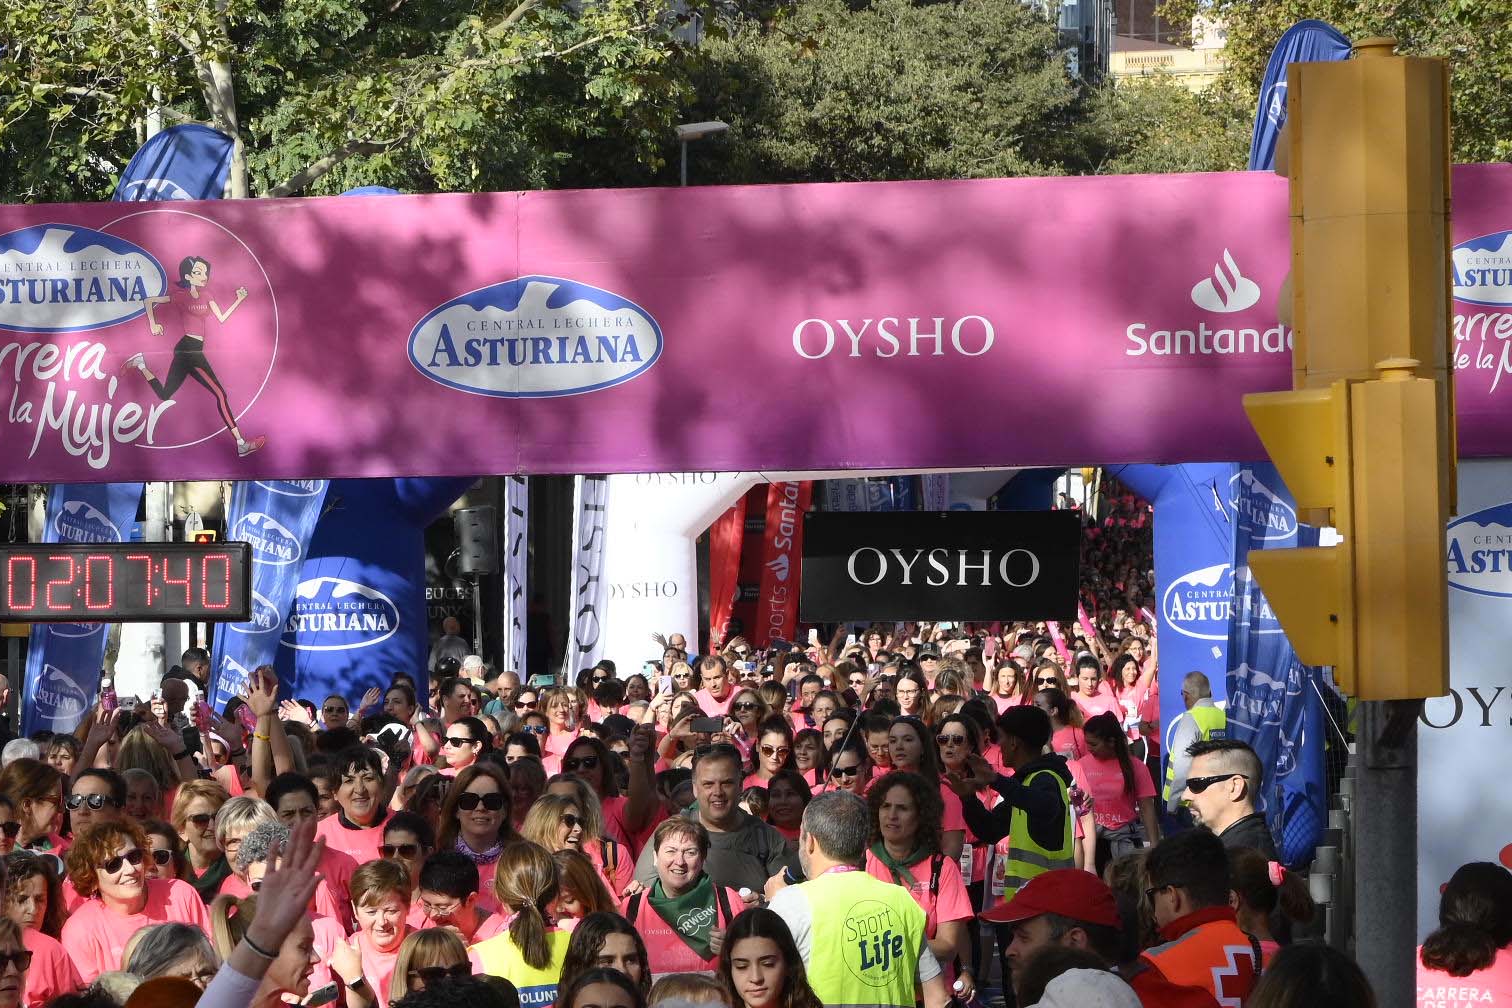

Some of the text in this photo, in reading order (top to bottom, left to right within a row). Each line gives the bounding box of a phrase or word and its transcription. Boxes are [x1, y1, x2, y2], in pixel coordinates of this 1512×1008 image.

[70, 260, 142, 272] LECHERA
[467, 315, 634, 332] CENTRAL LECHERA
[792, 315, 996, 358] OYSHO
[1126, 322, 1293, 356] Santand
[428, 323, 643, 368] ASTURIANA
[1476, 342, 1494, 369] la
[9, 384, 32, 424] la
[28, 375, 176, 470] Mujer
[775, 481, 800, 550] Santa
[847, 547, 1040, 587] OYSHO
[1448, 538, 1512, 574] AST
[8, 554, 231, 610] 02:07:40
[1187, 590, 1230, 598] CENTRA
[292, 602, 385, 611] ENTRAL LECHERA
[769, 586, 786, 643] ports
[1420, 686, 1512, 729] OY
[846, 908, 893, 941] Sport
[859, 930, 903, 971] Life
[519, 990, 558, 1003] OLUNT
[1417, 987, 1493, 1002] CARRERA
